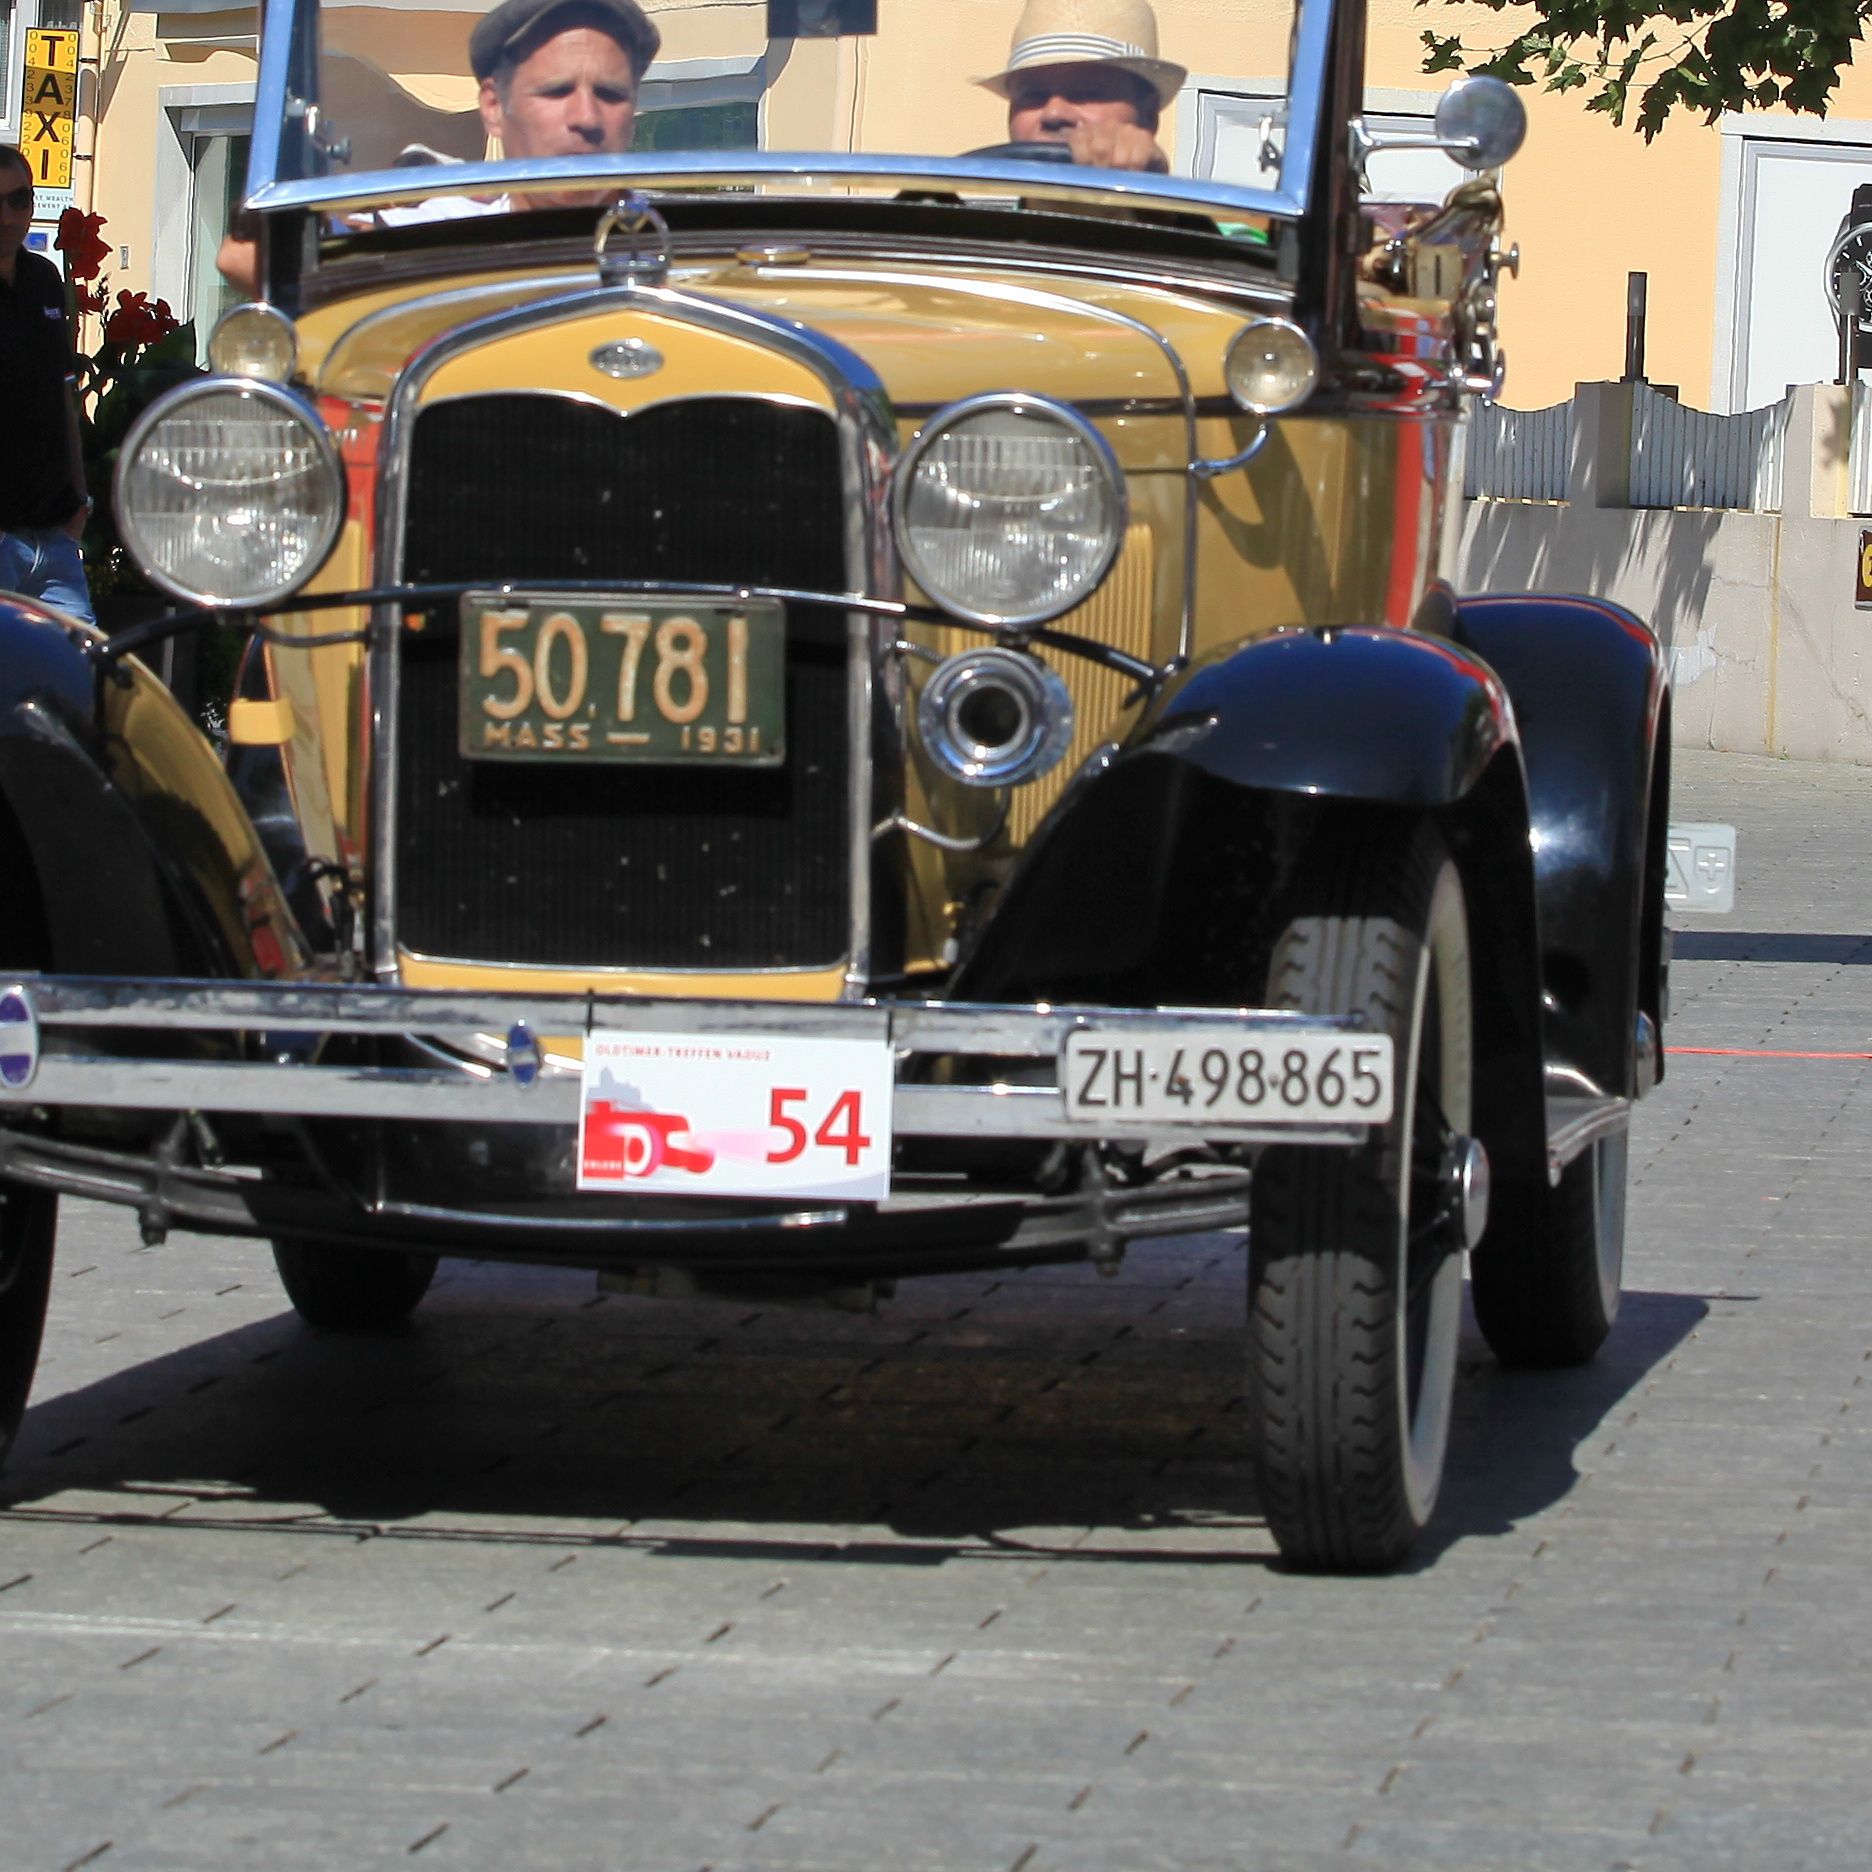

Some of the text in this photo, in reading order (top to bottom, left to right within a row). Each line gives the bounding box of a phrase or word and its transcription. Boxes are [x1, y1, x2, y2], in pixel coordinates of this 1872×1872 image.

[33, 35, 65, 181] TAXI
[483, 721, 761, 754] MASS 1931
[765, 1087, 872, 1167] 54
